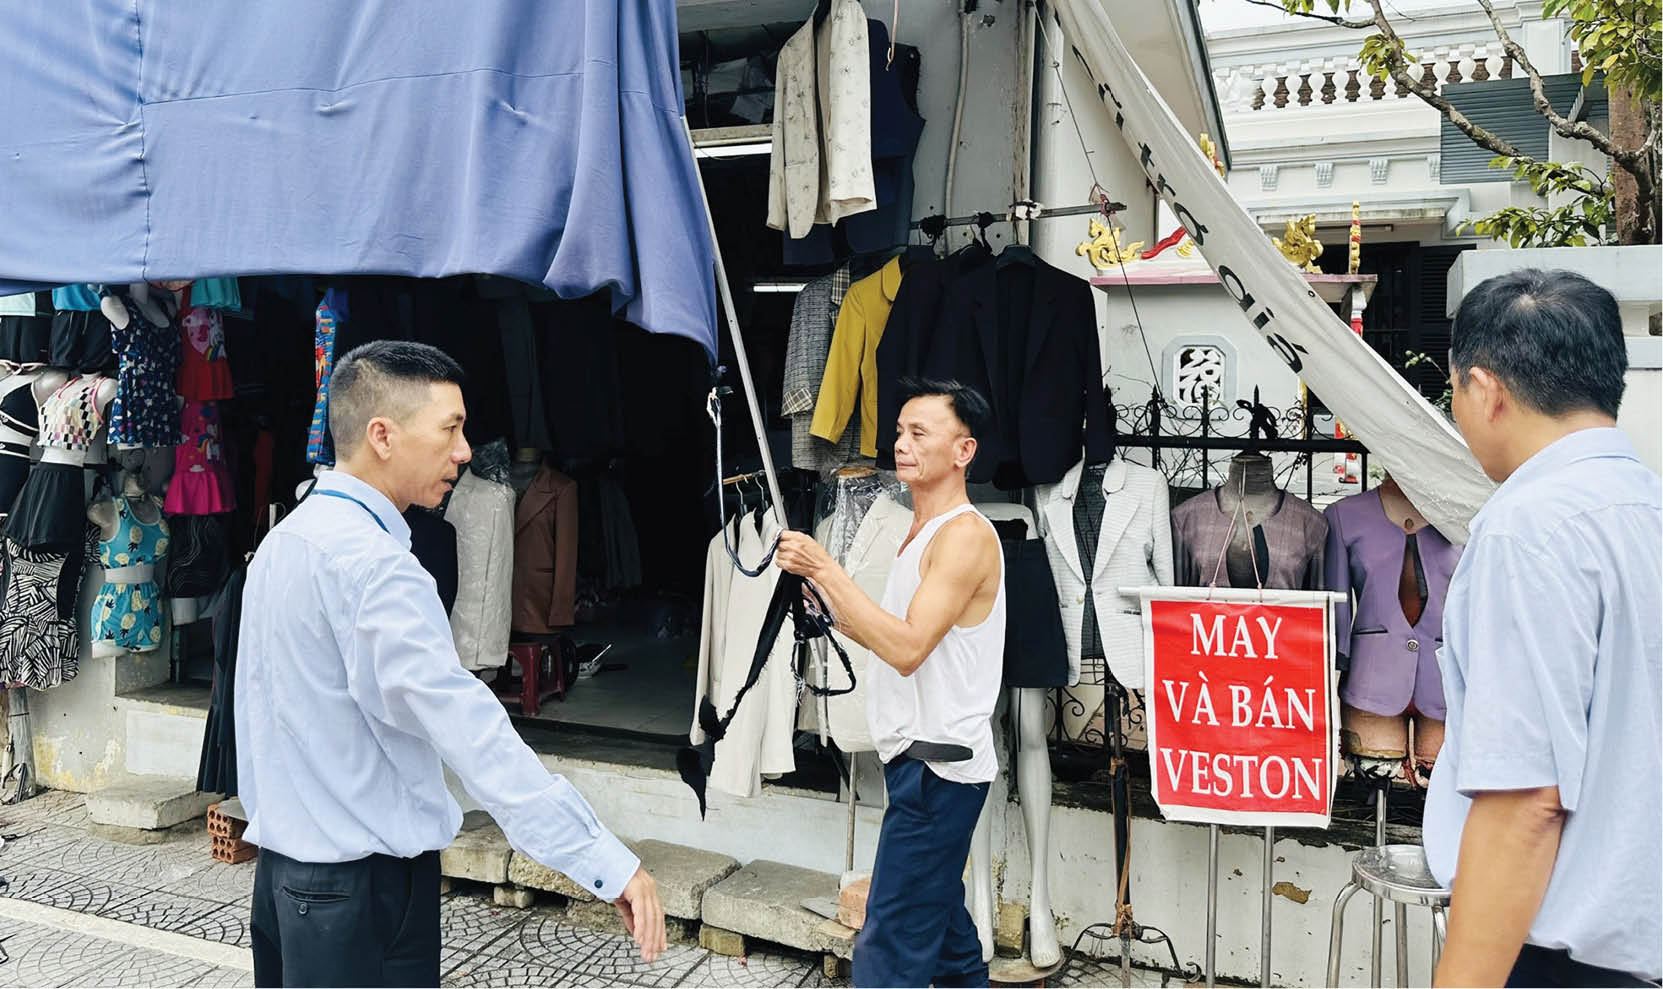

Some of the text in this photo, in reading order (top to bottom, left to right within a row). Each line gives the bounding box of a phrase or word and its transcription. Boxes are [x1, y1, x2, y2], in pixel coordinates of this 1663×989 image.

[1189, 613, 1283, 660] MAY
[1162, 670, 1316, 732] VÀ BÁN
[1160, 747, 1323, 801] VESTON
